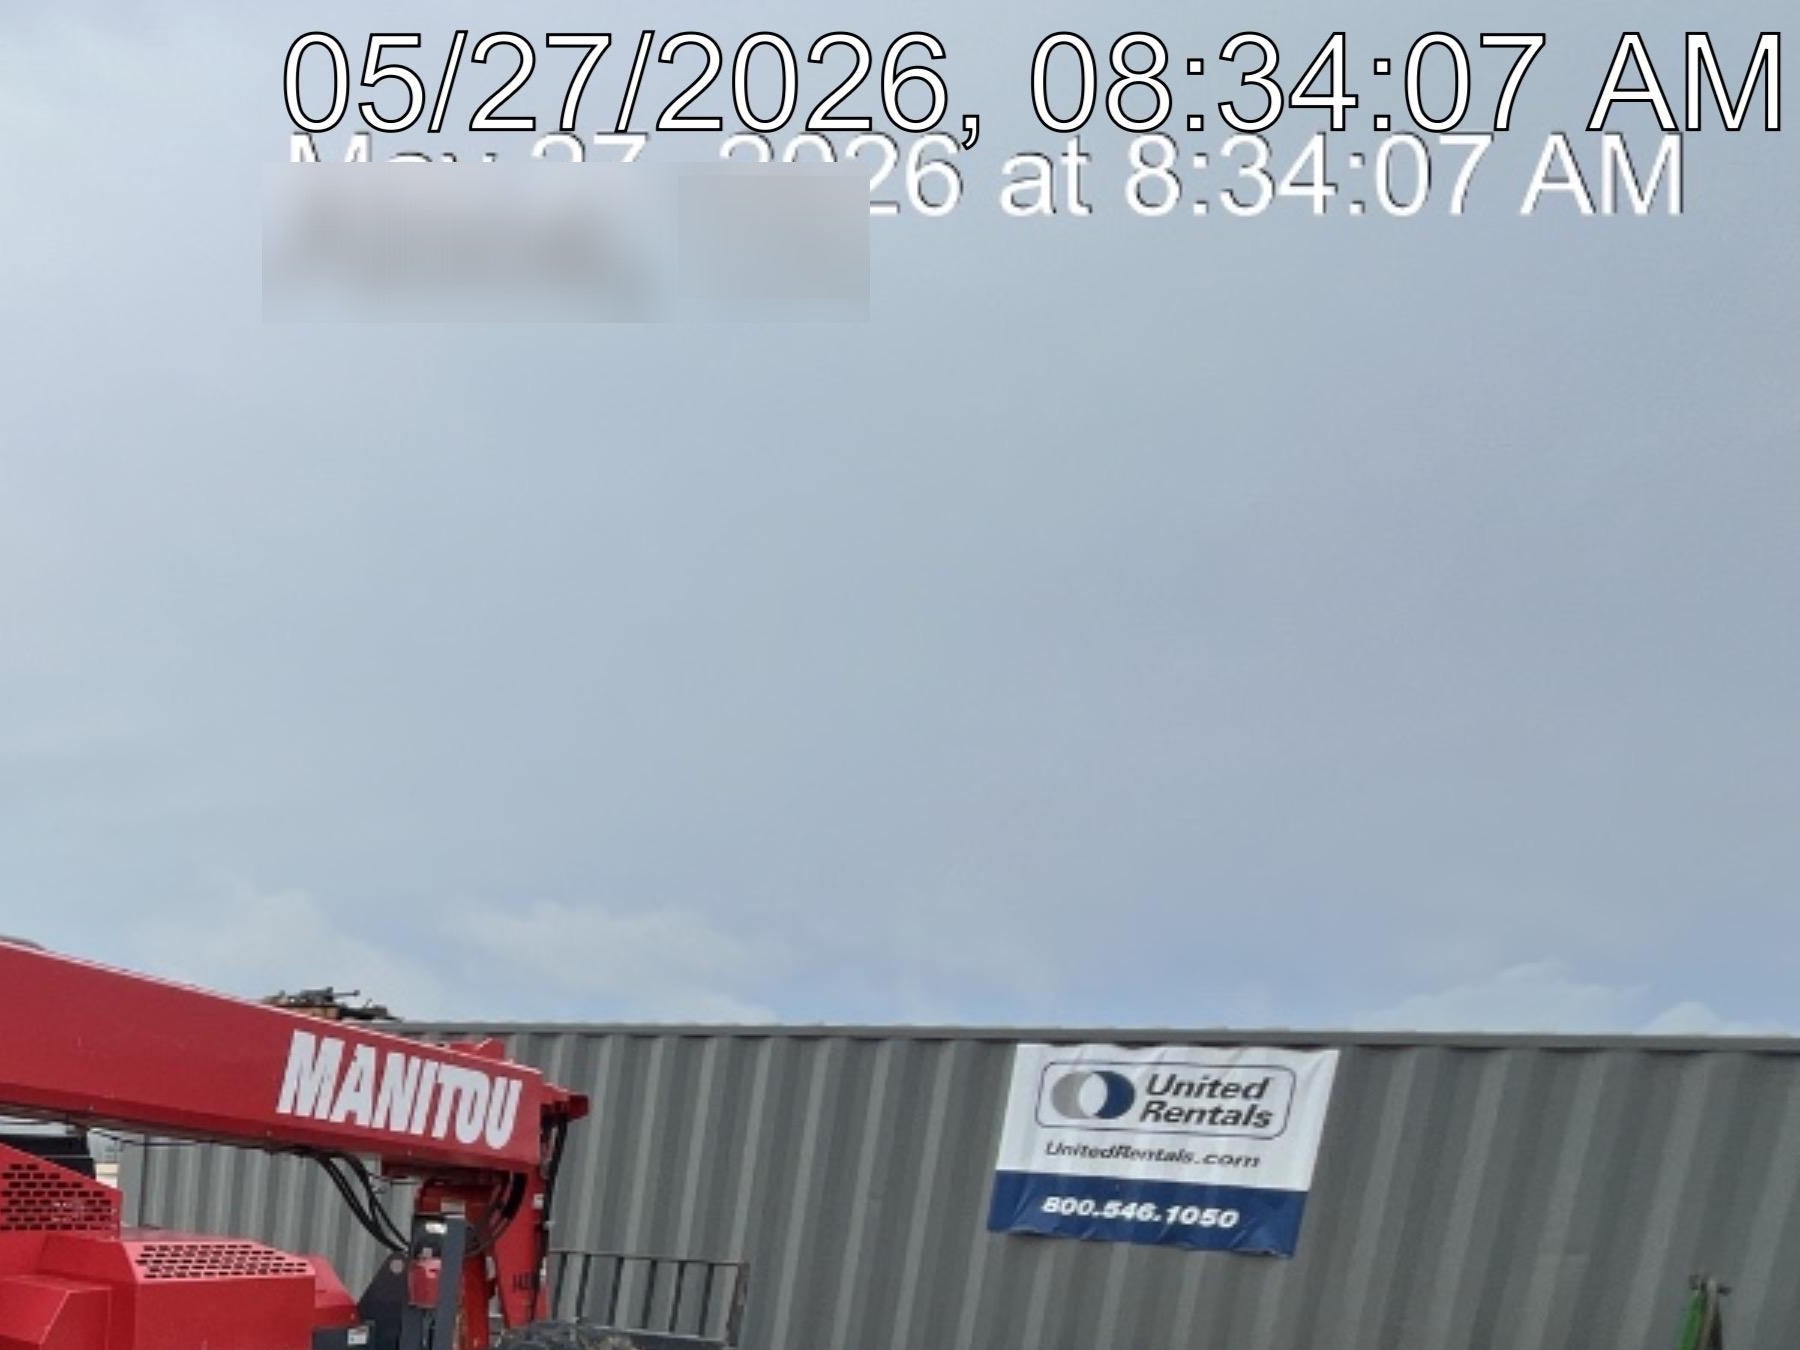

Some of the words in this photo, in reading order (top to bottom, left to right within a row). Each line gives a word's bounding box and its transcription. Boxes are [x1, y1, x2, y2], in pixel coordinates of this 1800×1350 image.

[276, 1029, 523, 1150] MANITOU
[1145, 1073, 1272, 1100] United
[1139, 1100, 1274, 1129] Rentals
[1046, 1141, 1261, 1168] UnitedRentals.com
[1042, 1196, 1241, 1228] 800.546.1050
